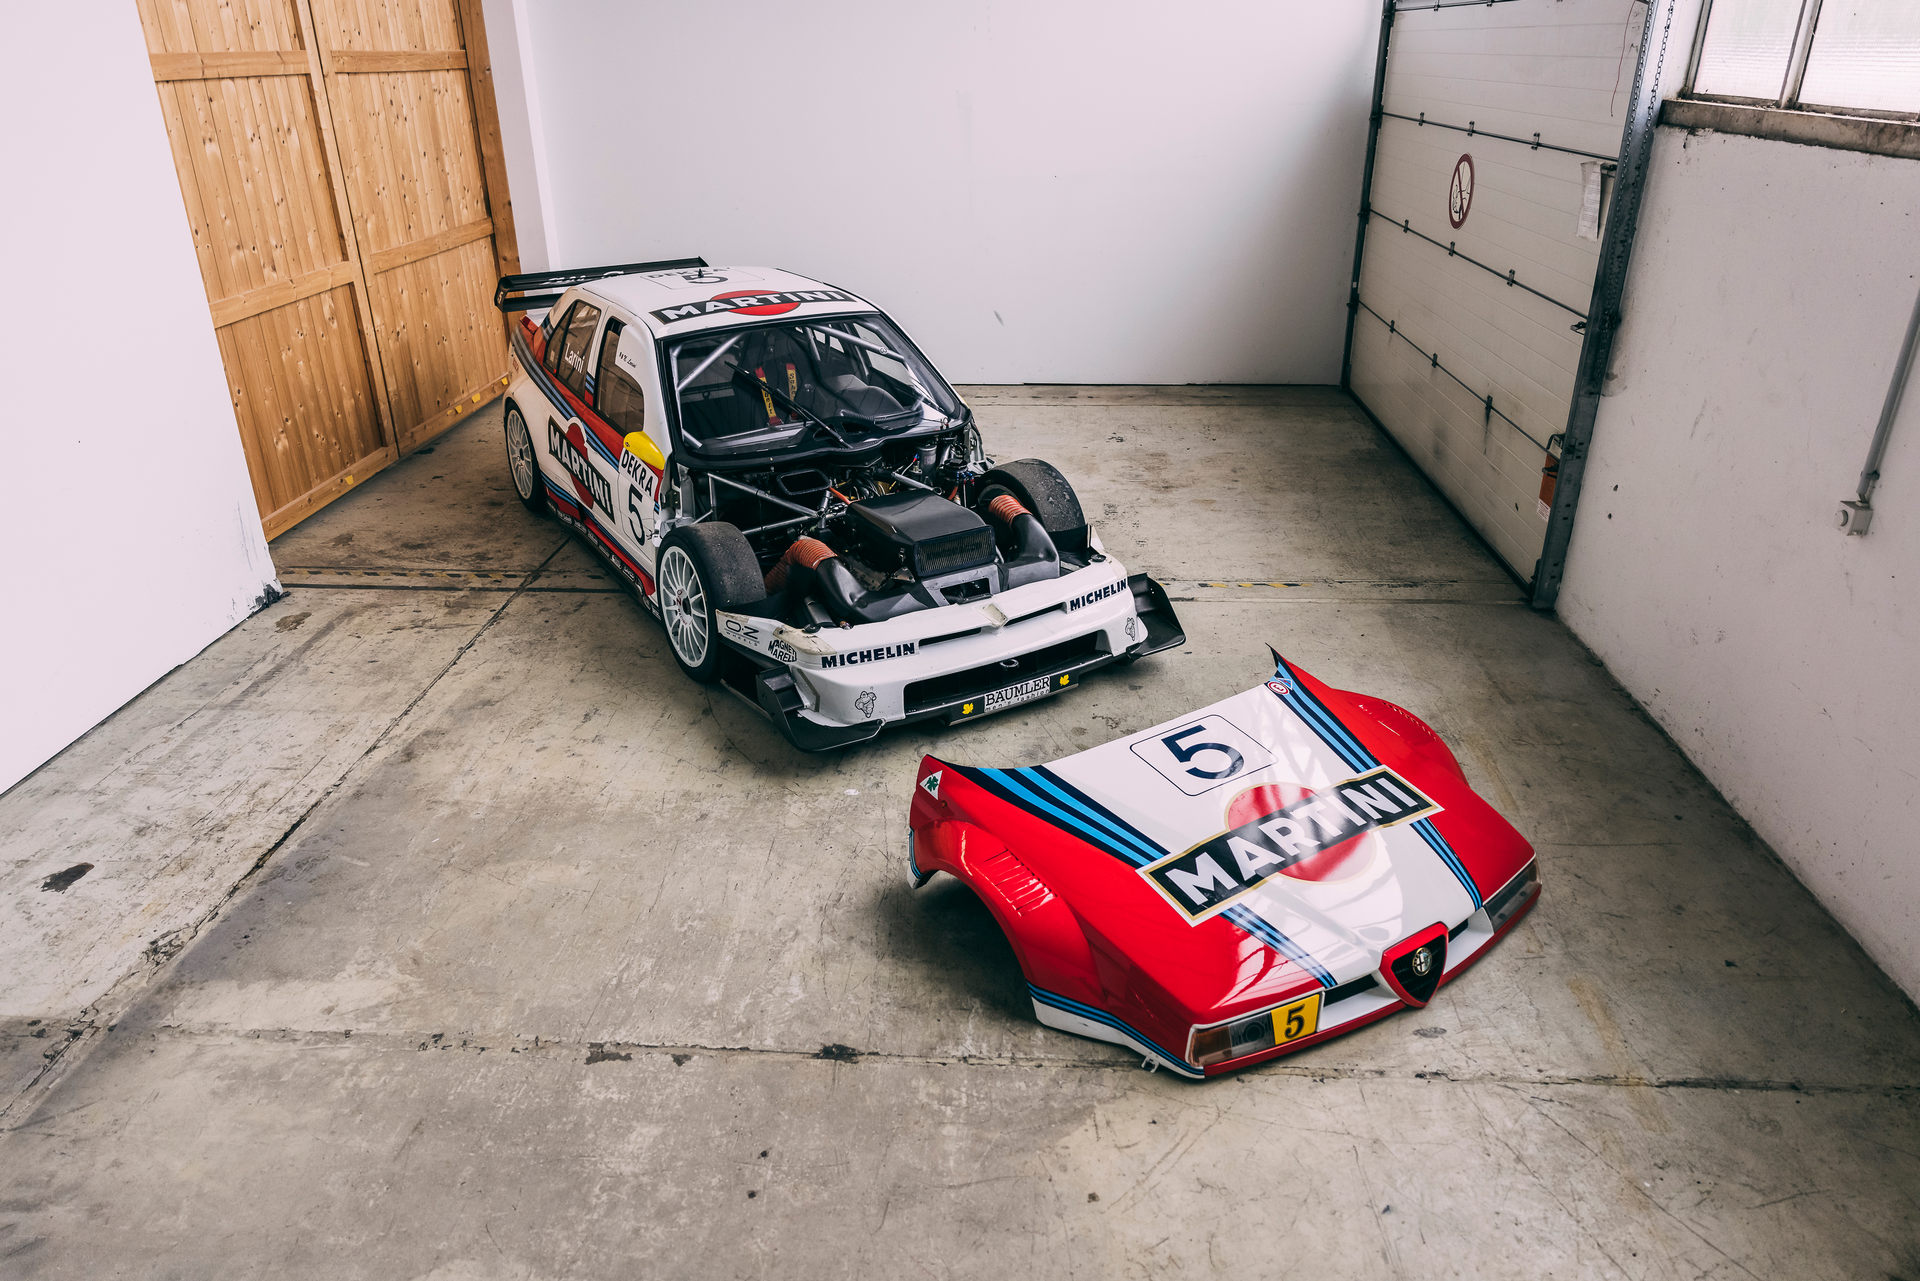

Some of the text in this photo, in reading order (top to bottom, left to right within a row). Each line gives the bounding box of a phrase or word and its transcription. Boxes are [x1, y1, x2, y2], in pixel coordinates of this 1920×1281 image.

[682, 273, 728, 284] 5
[661, 291, 845, 320] MARTINI
[564, 342, 585, 374] Larini
[550, 424, 612, 514] MARTINI
[621, 449, 654, 497] DEKRA
[628, 483, 645, 546] 5
[1070, 578, 1127, 611] MICHELIN
[821, 642, 915, 668] MICHELIN
[986, 677, 1050, 707] BÄUMLER
[1161, 724, 1245, 779] 5
[1164, 777, 1418, 906] MARTINI
[1284, 1003, 1305, 1039] 5
